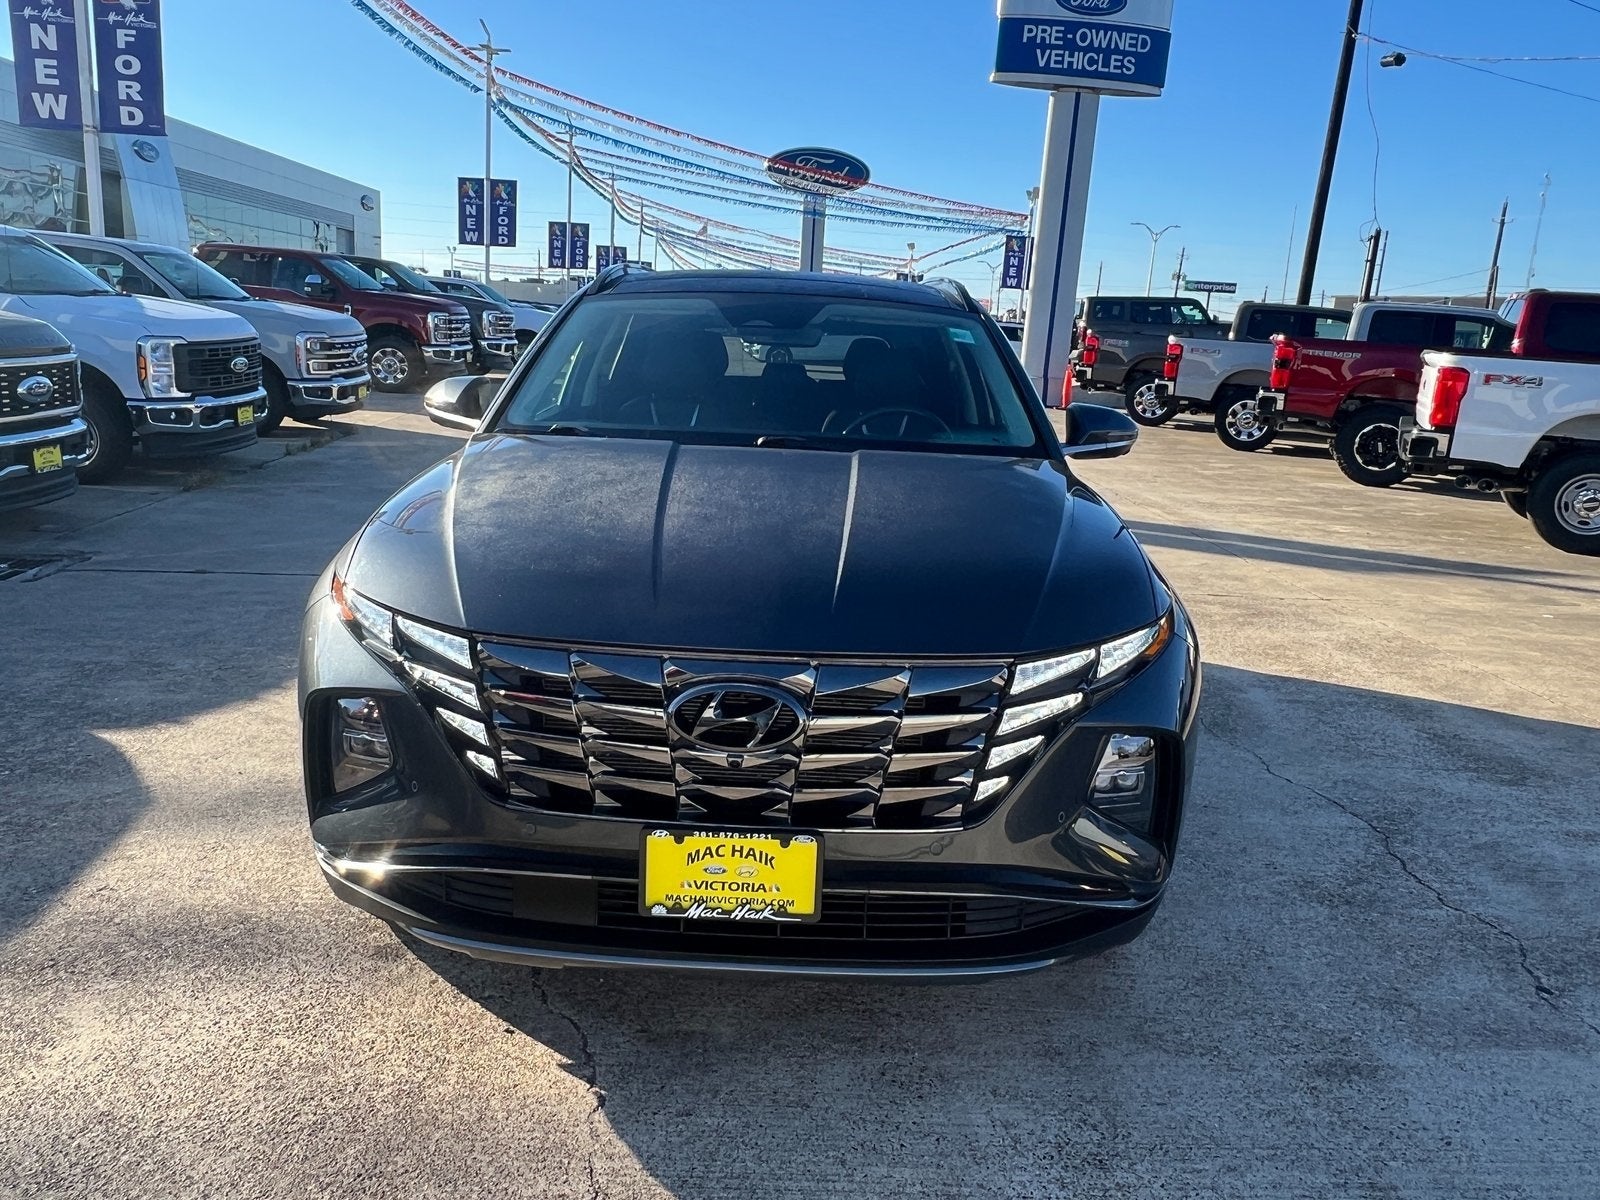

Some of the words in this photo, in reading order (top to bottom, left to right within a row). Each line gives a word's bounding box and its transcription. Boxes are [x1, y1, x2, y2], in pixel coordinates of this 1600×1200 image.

[1071, 0, 1110, 8] ord
[30, 23, 67, 120] NEW
[1036, 49, 1136, 75] VEHICLES
[114, 28, 144, 126] FORD
[464, 204, 479, 242] NEW
[497, 206, 509, 245] FORD
[552, 240, 562, 267] NEW
[575, 241, 584, 268] FORD
[1006, 256, 1019, 287] NEW
[1187, 282, 1236, 292] enterprise
[1308, 349, 1362, 359] TREMOR
[1482, 373, 1544, 387] FX4
[686, 844, 727, 867] MAC
[731, 844, 776, 870] HAIK
[693, 880, 767, 893] VICTORIA
[664, 894, 795, 908] MACHAIKVICTORIA.COM
[684, 902, 729, 919] Mac
[730, 904, 778, 920] Haik
